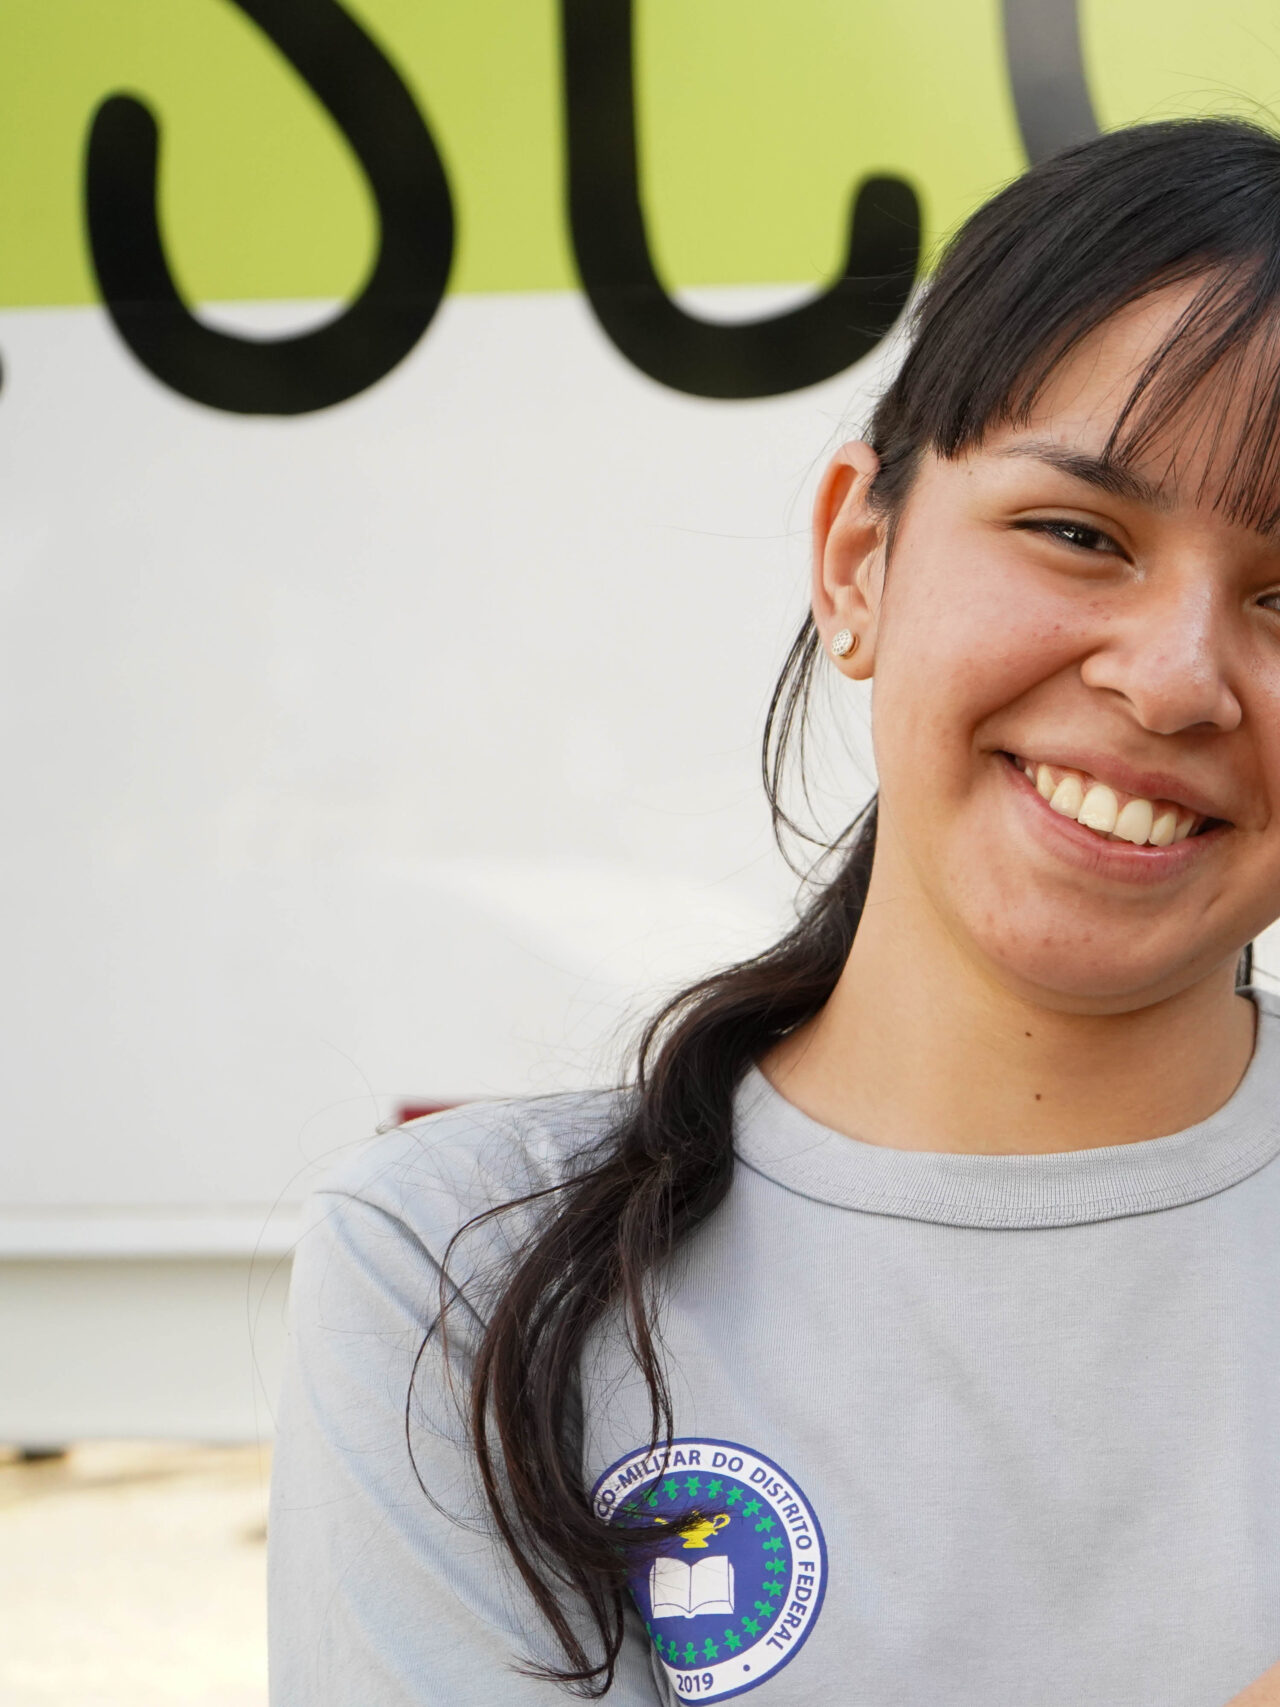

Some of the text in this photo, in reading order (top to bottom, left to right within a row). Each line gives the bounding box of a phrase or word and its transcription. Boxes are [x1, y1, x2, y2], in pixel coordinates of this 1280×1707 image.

[711, 1451, 744, 1473] DO
[749, 1466, 813, 1551] DISTRITO
[766, 1560, 815, 1651] FEDERAL
[676, 1672, 714, 1694] 2019
